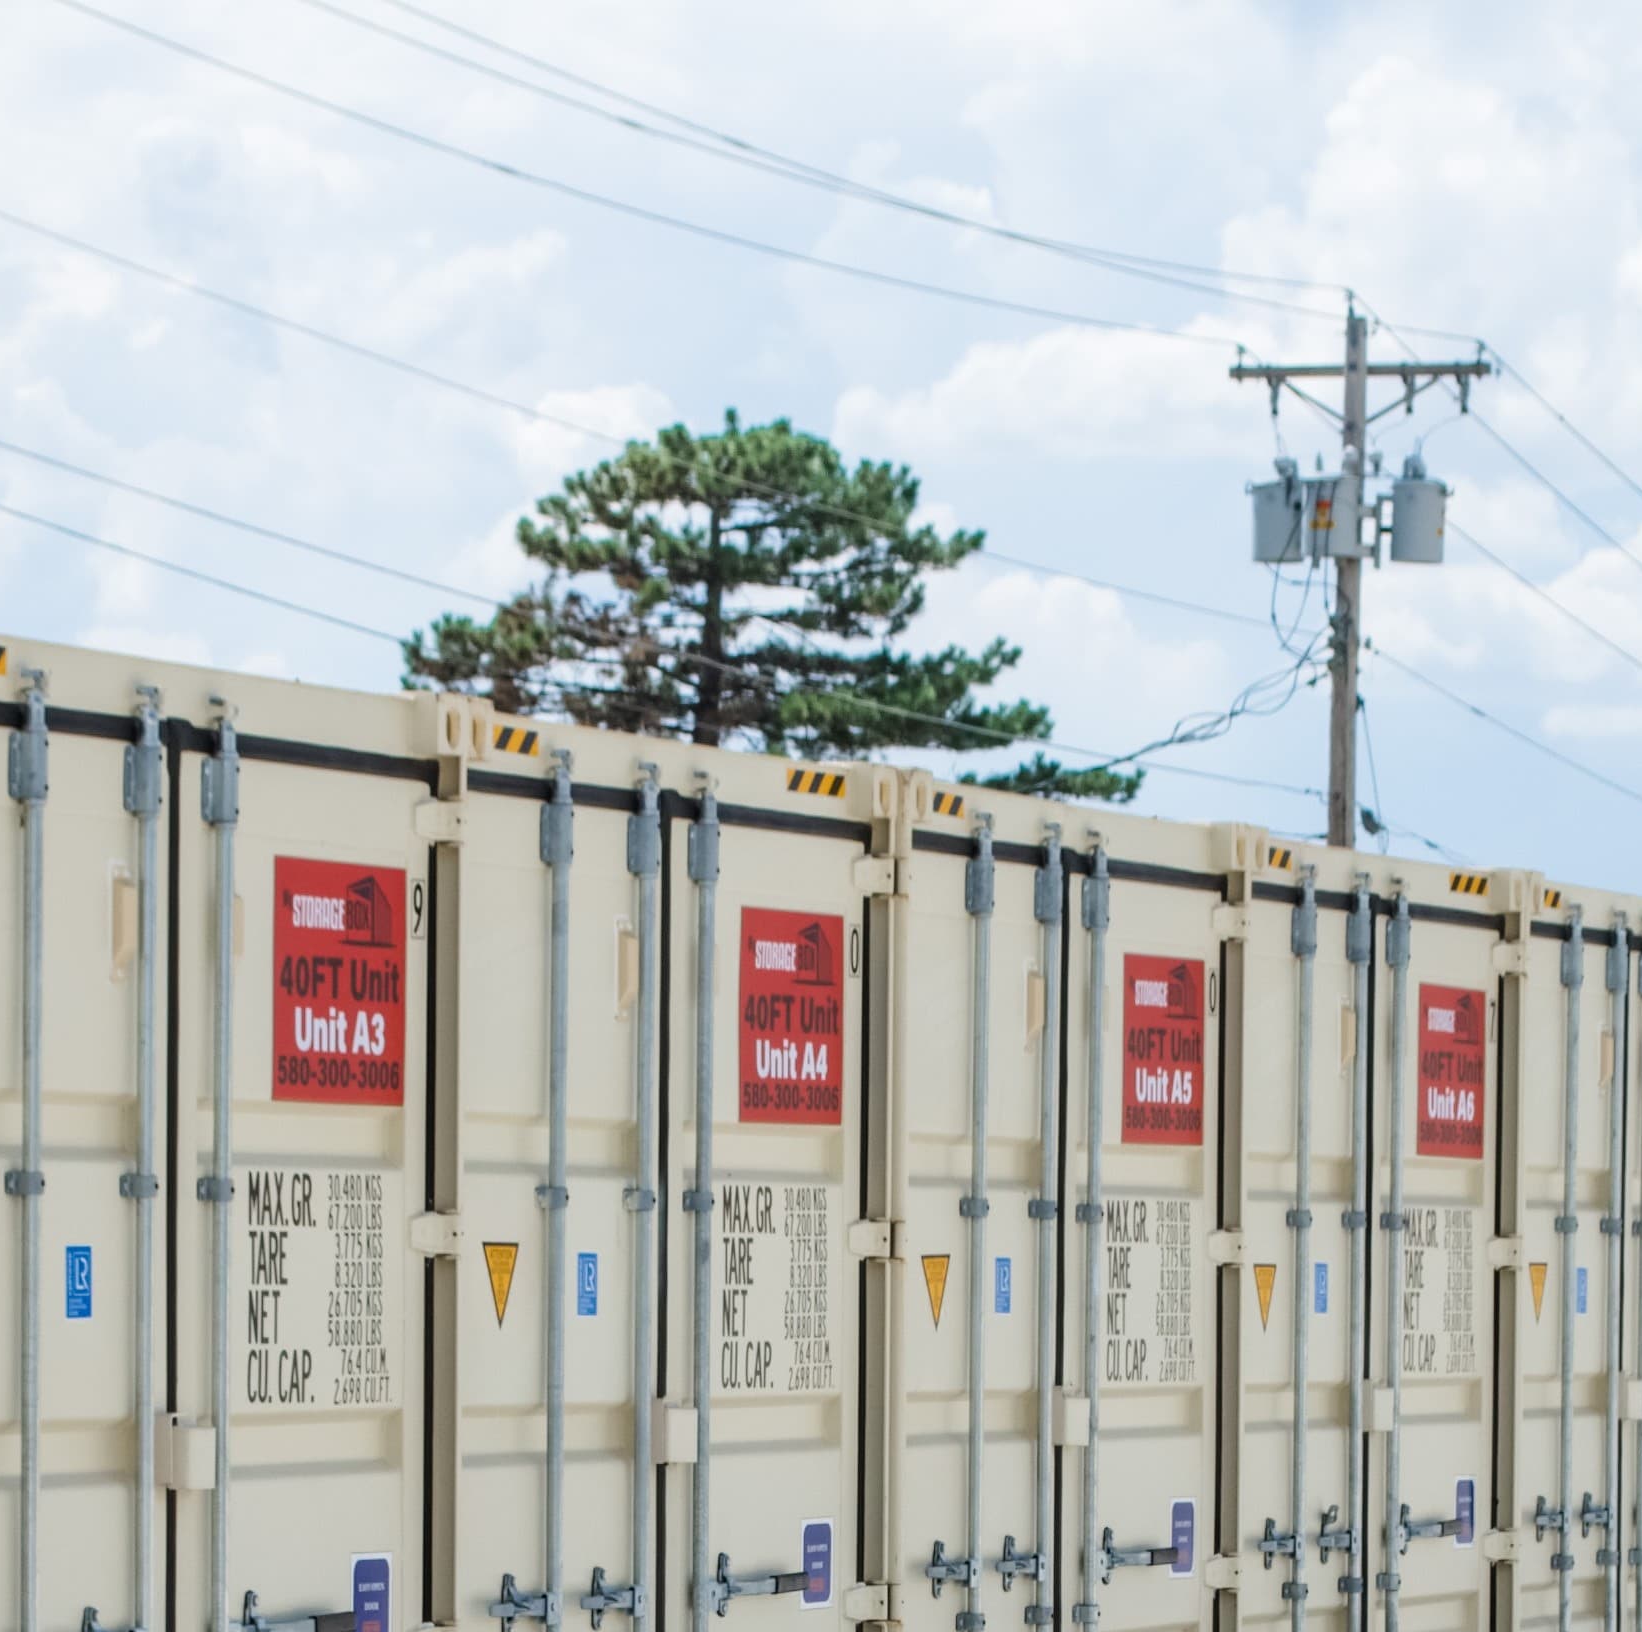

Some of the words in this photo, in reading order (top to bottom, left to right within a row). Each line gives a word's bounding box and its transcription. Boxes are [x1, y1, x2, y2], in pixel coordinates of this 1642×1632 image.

[293, 894, 345, 930] STORAGE
[414, 883, 423, 934] 9
[851, 928, 858, 974] 0
[280, 956, 343, 999] 40FT
[350, 960, 399, 1003] Unit
[295, 1007, 347, 1053] Unit
[352, 1011, 385, 1055] A3
[744, 995, 793, 1032] 40FT
[801, 998, 838, 1035] Unit
[756, 1039, 797, 1079] Unit
[801, 1042, 828, 1080] A4
[1128, 1028, 1166, 1060] 40FT
[1171, 1031, 1201, 1063] Unit
[278, 1056, 399, 1090] 580-300-3006
[1135, 1067, 1168, 1103] Unit
[1171, 1070, 1192, 1104] A5
[743, 1083, 838, 1111] 580-300-3006
[1428, 1086, 1455, 1120] Unit
[1458, 1090, 1475, 1122] A6
[249, 1231, 288, 1285] TARE
[723, 1238, 753, 1285] TARE
[1107, 1247, 1131, 1289] TARE
[249, 1290, 280, 1344] NET
[723, 1290, 748, 1337] NET
[1107, 1293, 1126, 1335] NET
[248, 1349, 272, 1403] CU.
[278, 1349, 314, 1403] CAP.
[722, 1341, 740, 1389] CU.
[746, 1341, 773, 1389] CAP.
